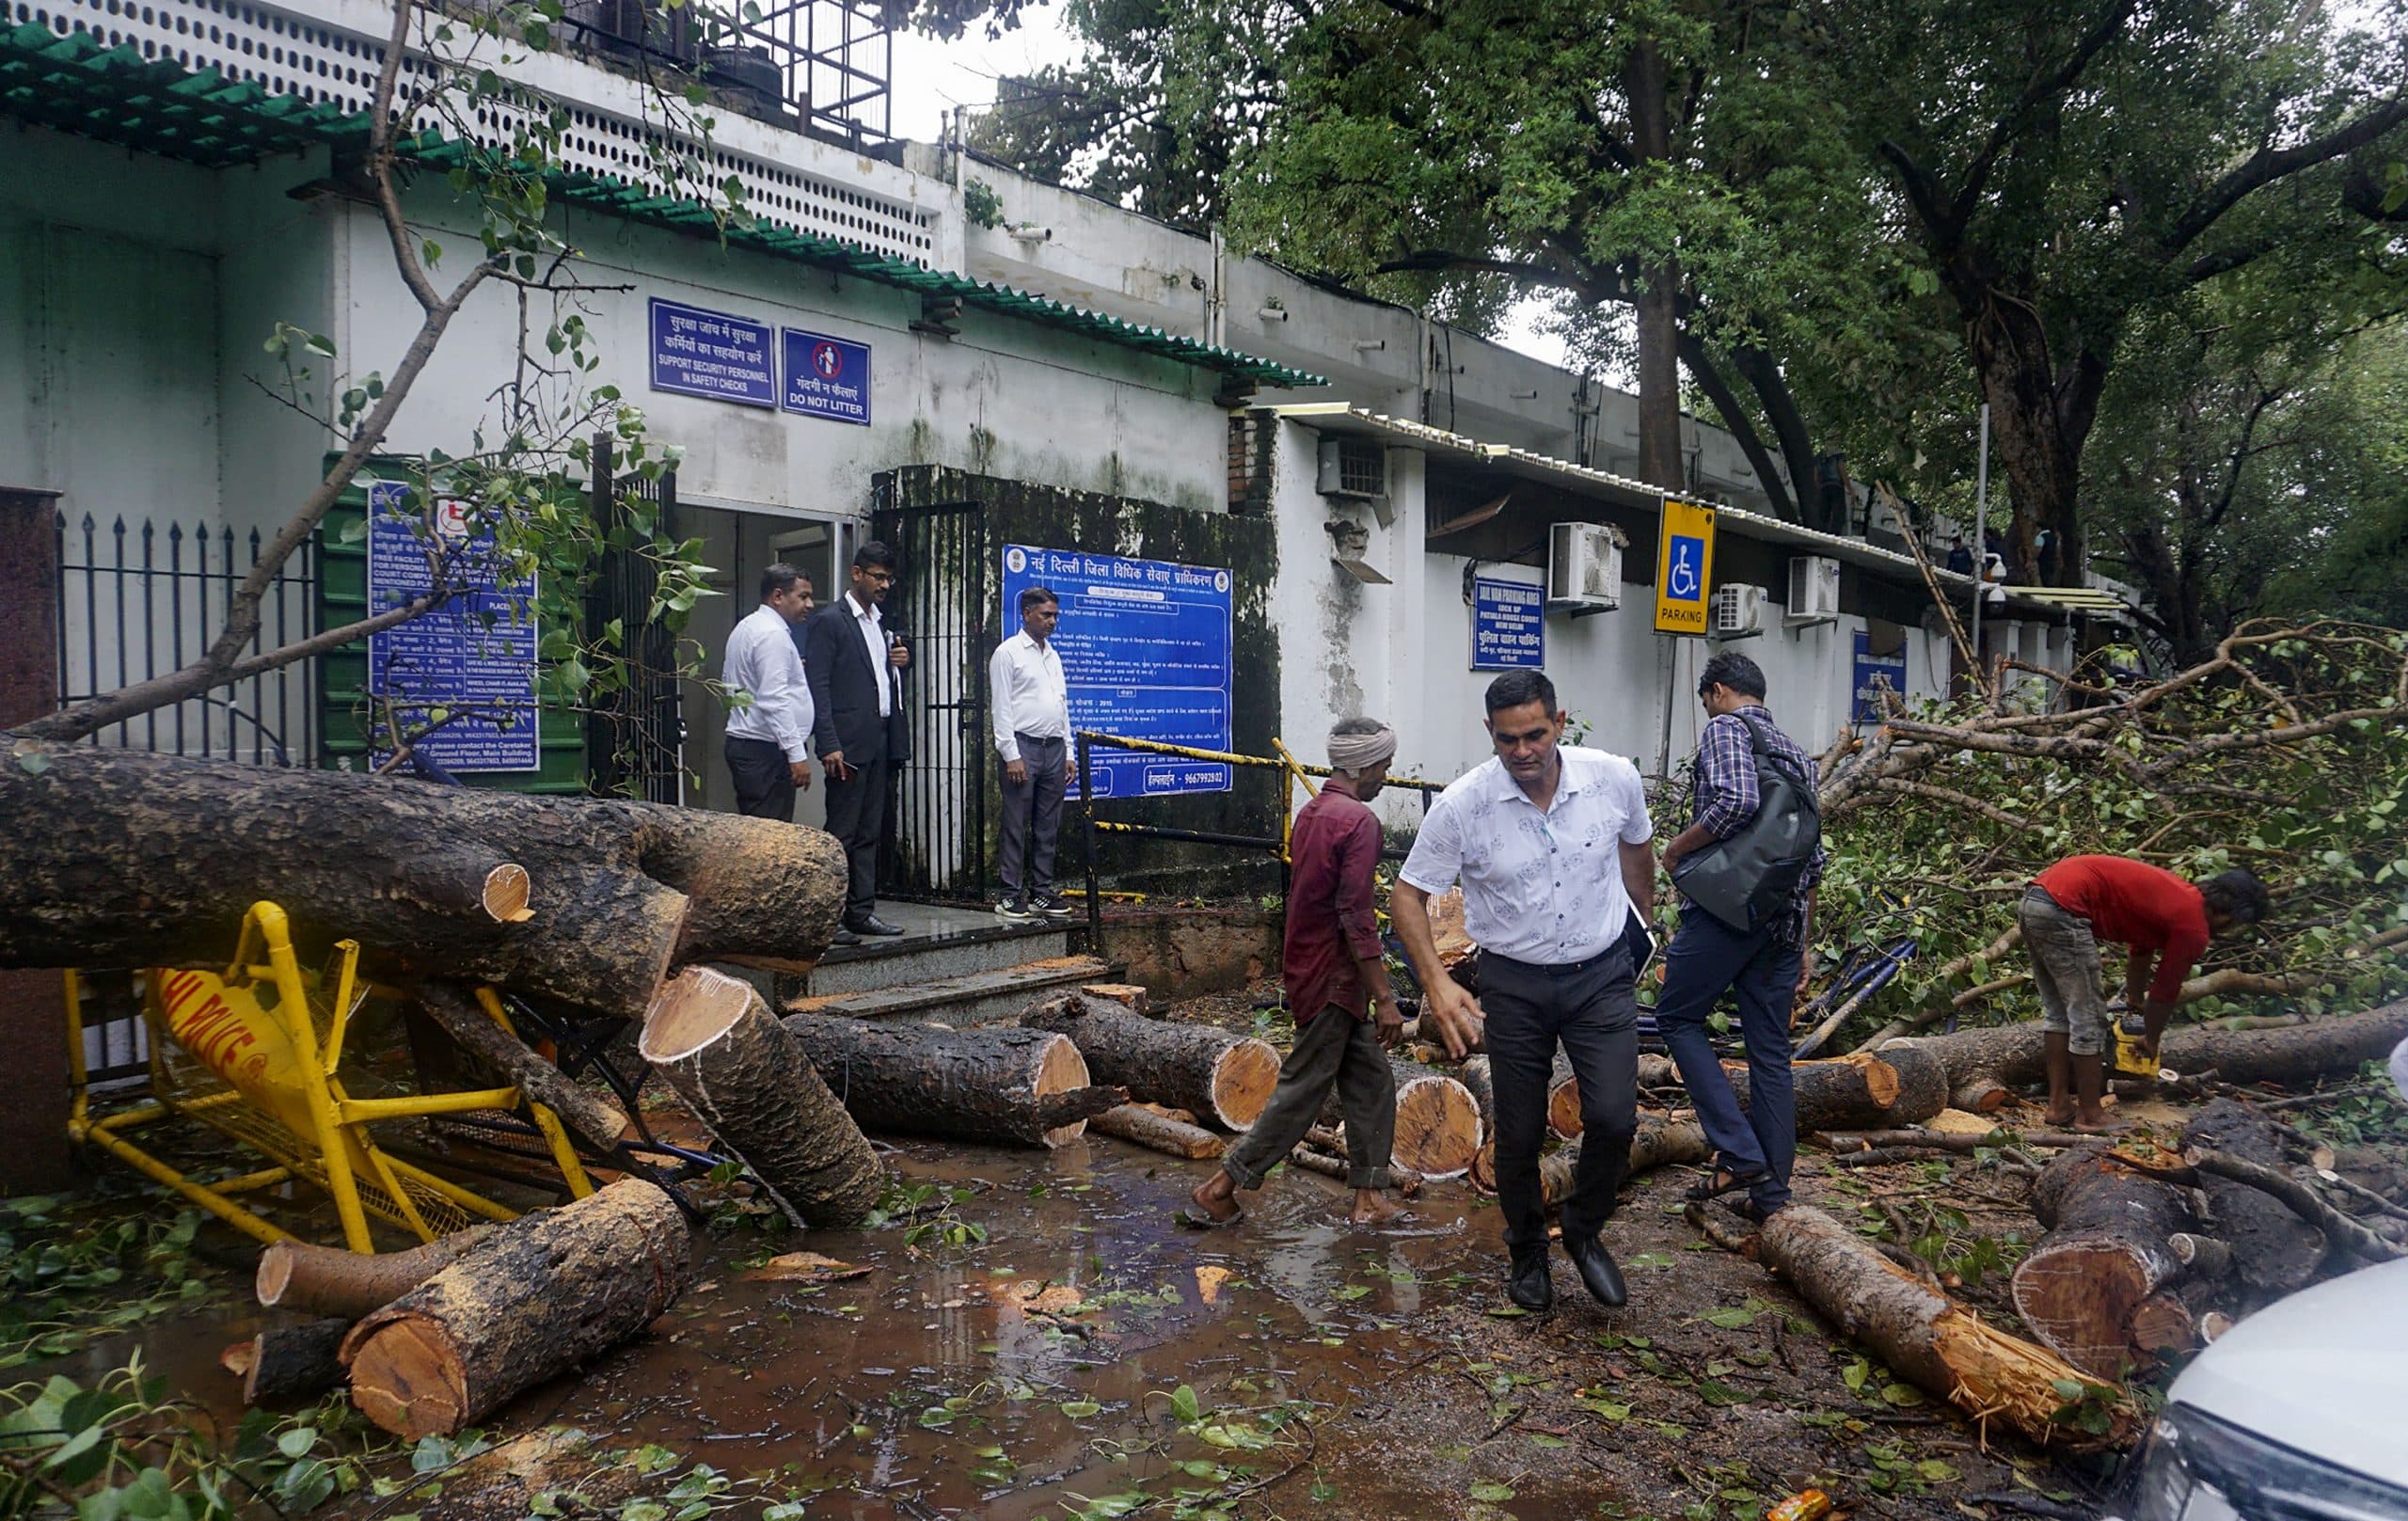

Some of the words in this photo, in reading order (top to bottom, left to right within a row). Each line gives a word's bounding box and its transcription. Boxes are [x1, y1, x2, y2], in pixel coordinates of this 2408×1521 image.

[669, 315, 697, 332] सुरक्षा
[699, 319, 720, 335] जांच
[721, 323, 730, 338] में
[732, 327, 756, 344] सुरक्षा
[664, 335, 696, 353] कर्मियों
[698, 342, 711, 355] का
[713, 345, 745, 361] सहयोग
[746, 350, 763, 364] करें
[657, 354, 691, 370] SUPPORT
[692, 359, 728, 375] SECURITY
[728, 366, 769, 384] PERSONNEL
[682, 372, 690, 383] IN
[691, 373, 719, 388] SAFETY
[720, 378, 748, 392] CHECKS
[796, 375, 820, 393] गंदगी
[822, 383, 830, 395] न
[790, 392, 806, 405] DO
[807, 396, 829, 409] NOT
[831, 399, 863, 415] LITTER
[1031, 553, 1046, 573] नई
[1051, 555, 1080, 574] दिल्ली
[1085, 559, 1109, 577] जिला
[1114, 562, 1142, 579] विधिक
[1147, 565, 1171, 584] सेवाएं
[1174, 571, 1212, 588] प्राधिकरण
[1662, 608, 1702, 623] PARKING
